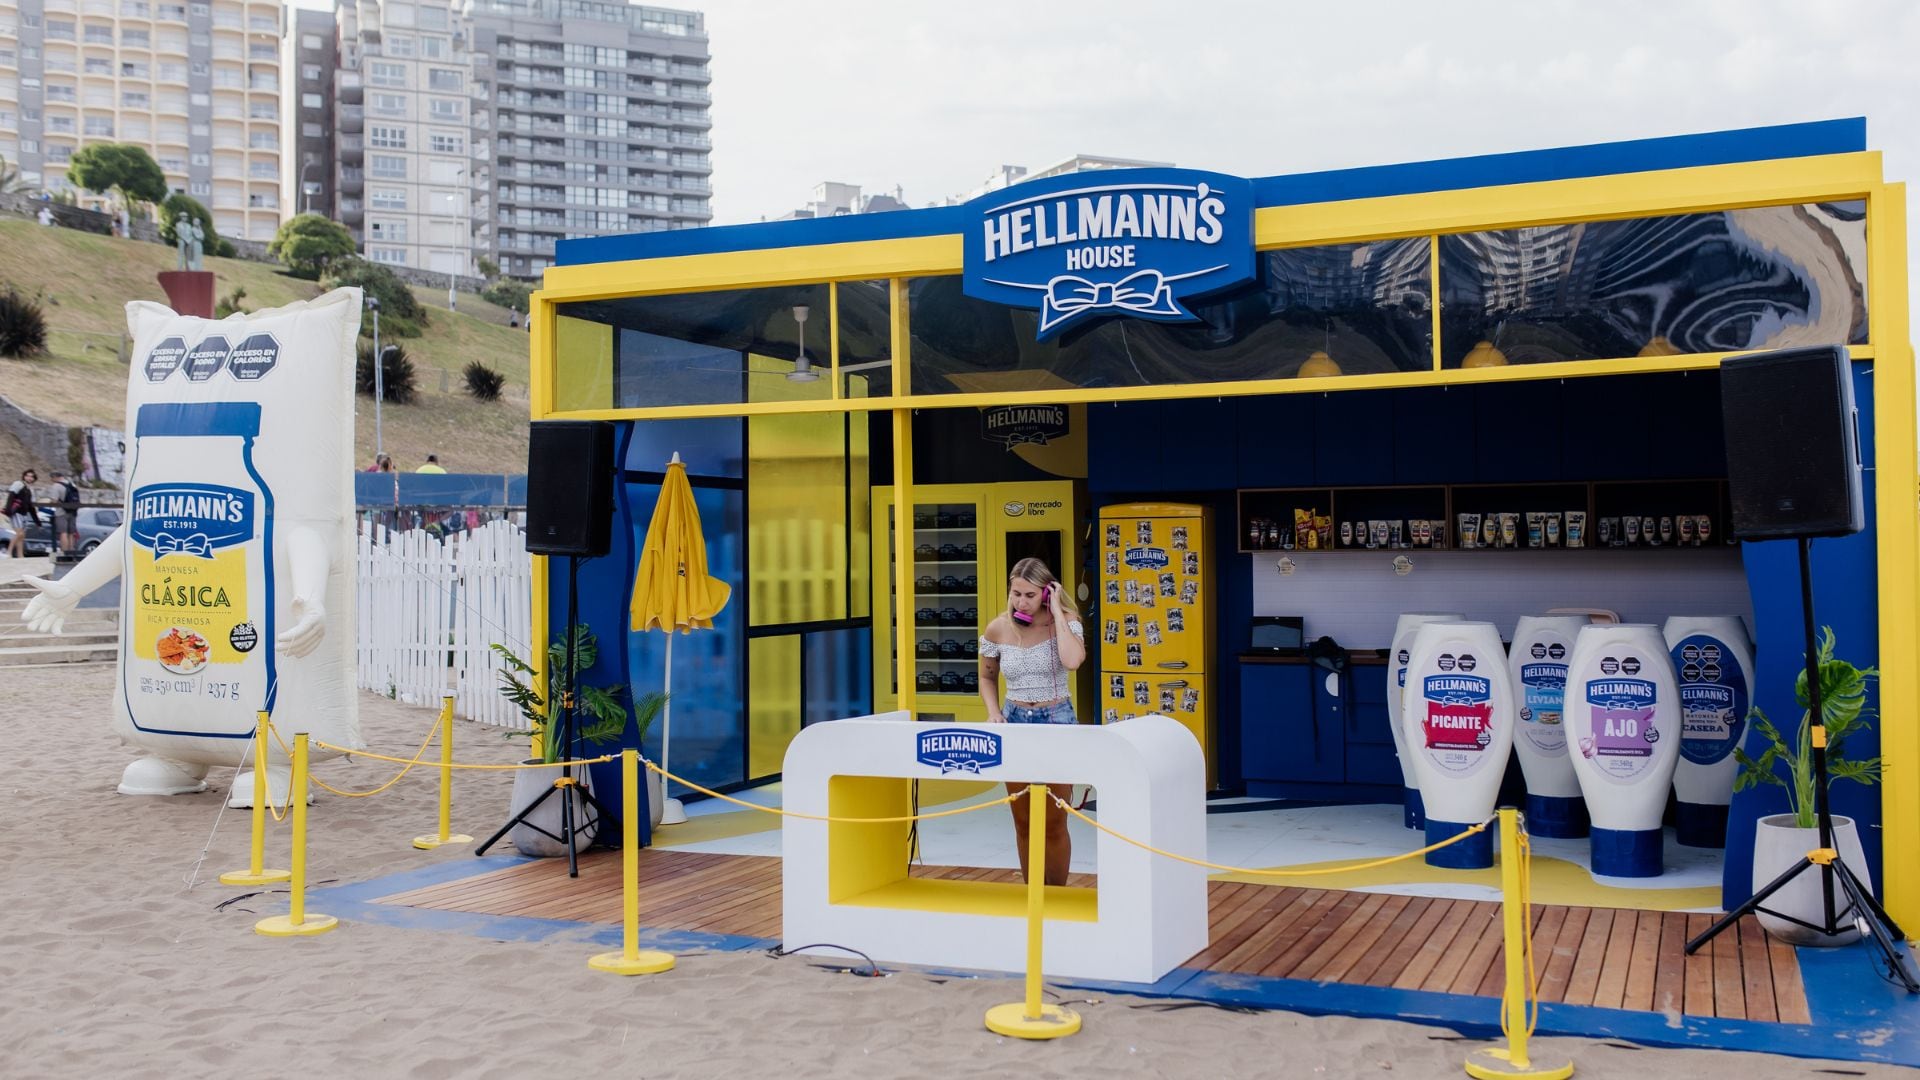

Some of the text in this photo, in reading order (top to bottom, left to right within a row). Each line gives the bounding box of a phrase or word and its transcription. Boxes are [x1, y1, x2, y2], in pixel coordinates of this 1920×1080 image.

[984, 183, 1225, 262] HELLMANN'S
[1066, 245, 1136, 270] HOUSE
[233, 349, 262, 357] EXCESO
[234, 356, 272, 364] CALORÍAS
[987, 406, 1064, 429] HELLMANN'S
[135, 493, 243, 523] HELLMANN'S
[1028, 500, 1062, 508] mercado
[1028, 508, 1045, 516] libre
[163, 521, 197, 529] EST.1913
[155, 565, 199, 575] MAYONESA
[141, 576, 231, 607] CLÁSICA
[172, 616, 211, 625] CREMOSA
[155, 680, 172, 695] 250
[207, 683, 227, 699] 237
[231, 682, 240, 700] g
[1427, 680, 1487, 694] HELLMANN'S
[1590, 683, 1652, 697] HELLMANN'S
[1527, 695, 1563, 704] LIVIAN
[1682, 690, 1729, 702] ELLMANN'S
[1431, 714, 1482, 729] PICANTE
[1604, 718, 1638, 738] AJO
[1682, 724, 1724, 733] CASERA
[922, 736, 997, 756] HELLMANN'S
